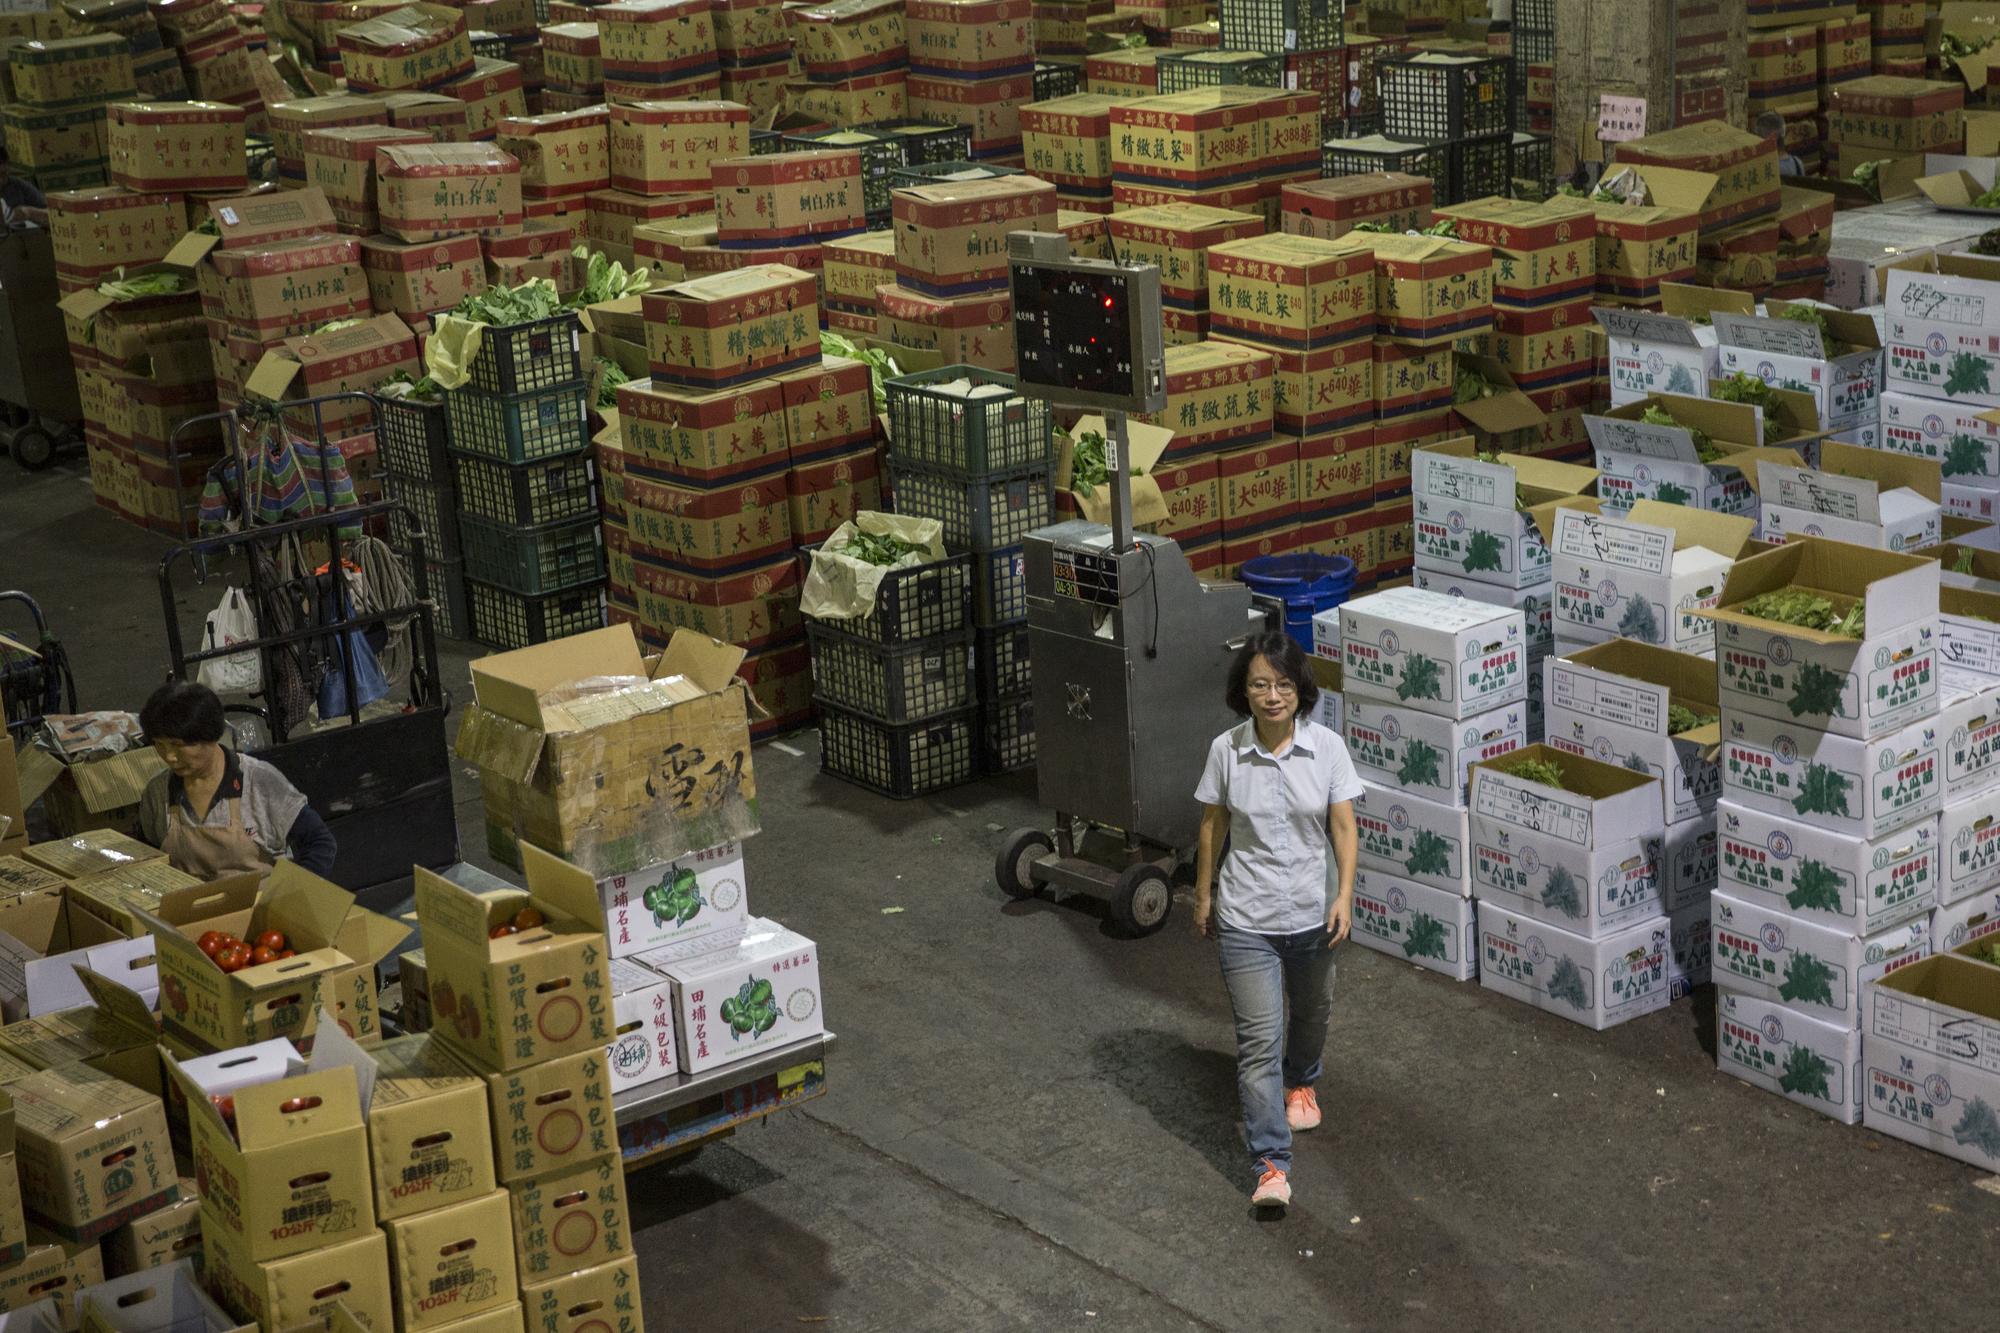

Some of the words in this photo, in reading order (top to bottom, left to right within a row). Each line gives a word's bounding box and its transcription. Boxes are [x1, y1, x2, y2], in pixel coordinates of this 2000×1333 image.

[1120, 133, 1184, 163] 精緻蔬菜
[1222, 259, 1286, 282] 二崙鄉農會
[1548, 251, 1580, 277] 大華
[1218, 284, 1291, 319] 精緻蔬菜
[1320, 287, 1363, 318] 大640華
[663, 334, 693, 358] 大華
[727, 313, 808, 358] 精緻蔬菜
[1185, 362, 1257, 390] 二崙鄉農會
[1317, 374, 1364, 404] 大640華
[813, 404, 850, 433] 大華
[1179, 390, 1262, 428] 精緻蔬菜
[629, 422, 694, 460] 精緻蔬菜
[730, 427, 765, 454] 大華
[1238, 476, 1288, 509] 大640華
[1315, 463, 1363, 492] 大640華
[736, 517, 770, 545] 大華
[1725, 662, 1784, 689] 隼人瓜苗
[1876, 670, 1930, 700] 隼人瓜苗
[1729, 758, 1789, 787] 隼人瓜苗
[1881, 769, 1933, 801] 隼人瓜苗
[1725, 853, 1783, 882] 隼人瓜苗
[1875, 868, 1928, 899] 隼人瓜苗
[613, 875, 632, 945] 田埔名產
[1717, 943, 1775, 974] 隼人瓜苗
[582, 943, 608, 1041] 分級包裝
[508, 963, 535, 1059] 品質保證
[691, 989, 710, 1060] 田埔名產
[652, 993, 671, 1067] 分級包裝
[1722, 1032, 1775, 1065] 隼人瓜苗
[581, 1057, 608, 1151] 分級包裝
[1873, 1083, 1934, 1120] 隼人瓜苗
[507, 1077, 535, 1171] 品質保證
[390, 1177, 433, 1199] 10公斤
[597, 1159, 622, 1253] 分級包裝
[269, 1221, 314, 1241] 10公斤
[524, 1180, 550, 1273] 品質保證
[417, 1288, 460, 1312] 10公斤
